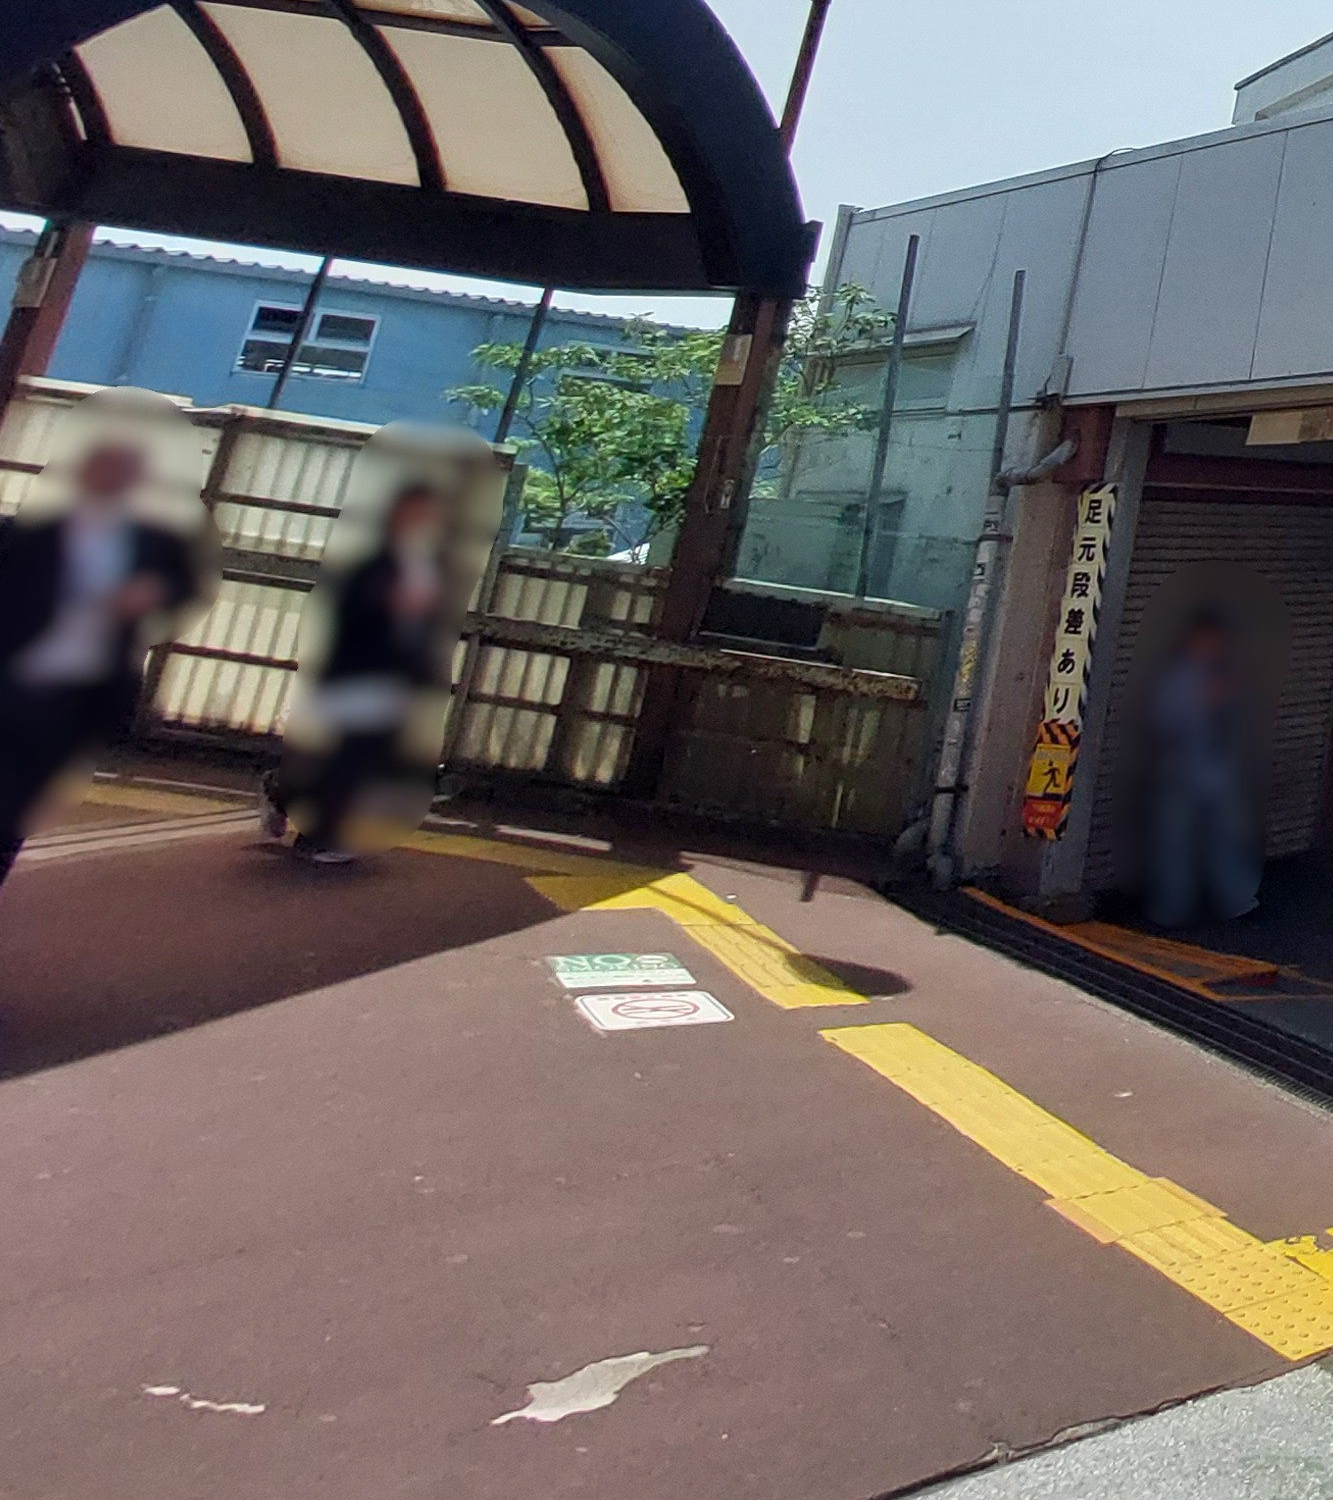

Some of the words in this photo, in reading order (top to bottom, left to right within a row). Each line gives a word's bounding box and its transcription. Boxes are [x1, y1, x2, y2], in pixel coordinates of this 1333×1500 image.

[1054, 499, 1103, 714] 足元段差あり
